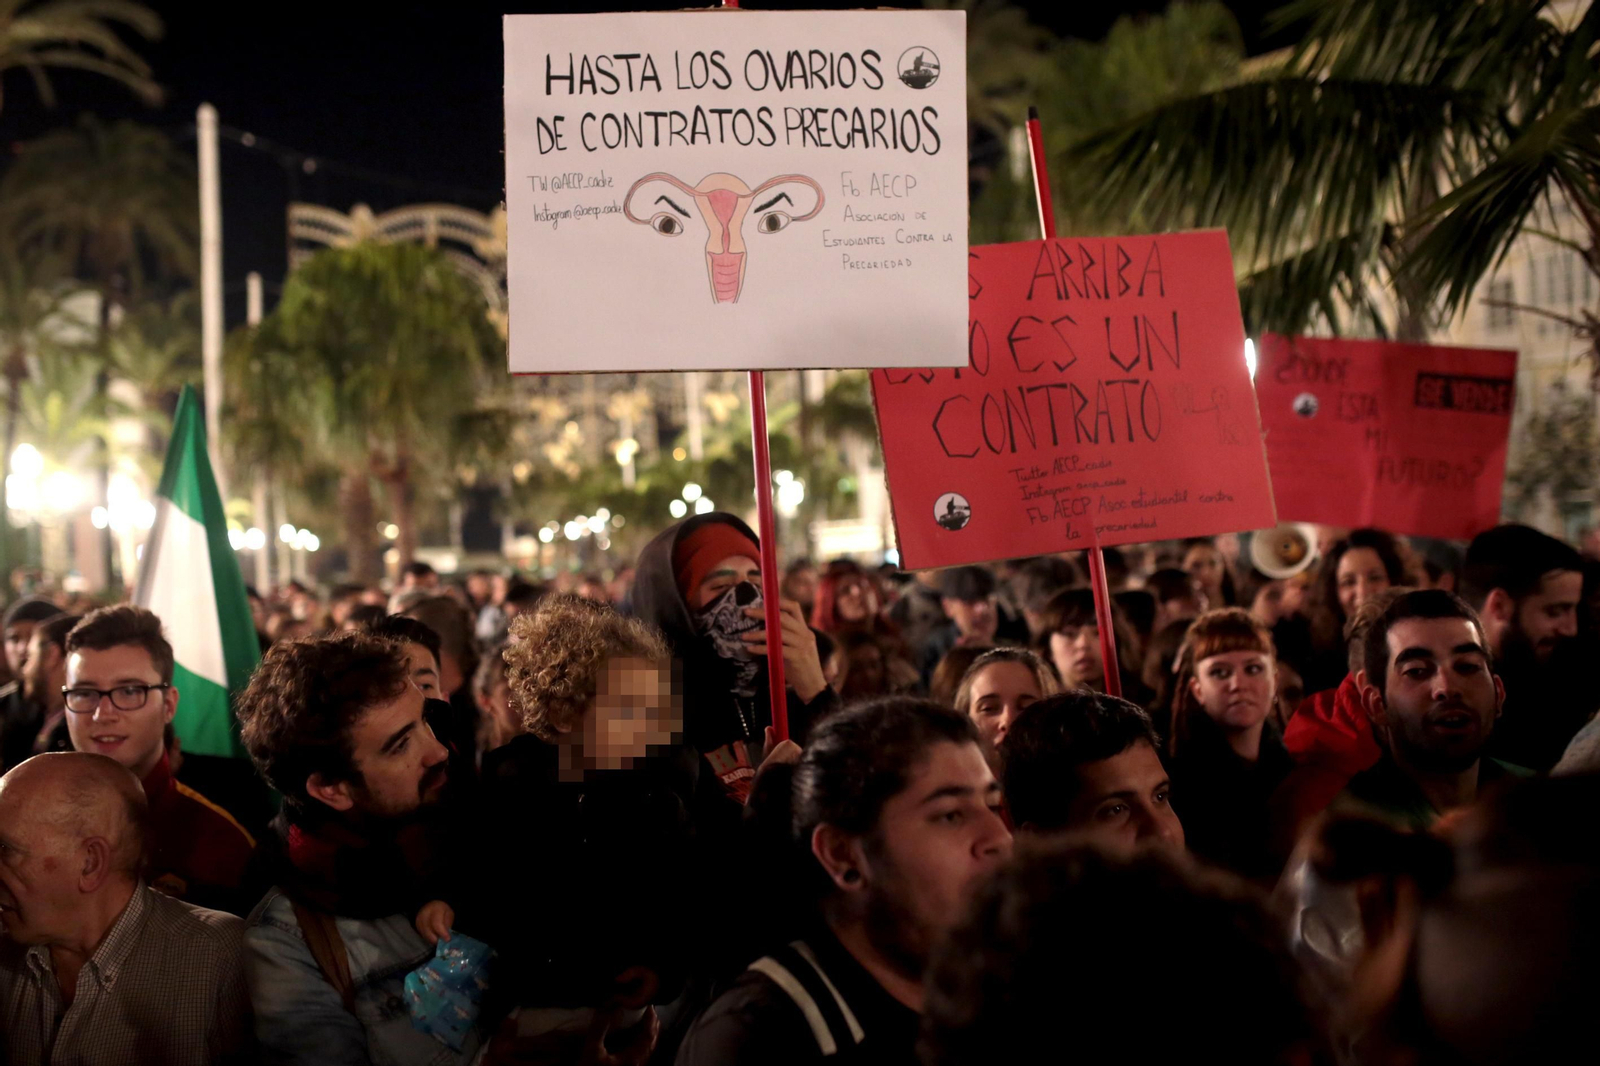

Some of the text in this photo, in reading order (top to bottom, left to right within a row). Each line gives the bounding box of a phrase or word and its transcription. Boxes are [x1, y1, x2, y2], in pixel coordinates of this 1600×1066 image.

[545, 49, 884, 95] HASTA LOS OVARIOS
[536, 105, 941, 155] DE CONTRATOS PRECARIOS
[870, 172, 917, 198] AECP
[533, 202, 572, 230] Instagram
[1027, 239, 1165, 301] ARRIBA
[1007, 315, 1078, 373] ES
[1105, 310, 1180, 371] UN
[933, 379, 1162, 459] CONTRATO
[1053, 496, 1091, 519] AECP
